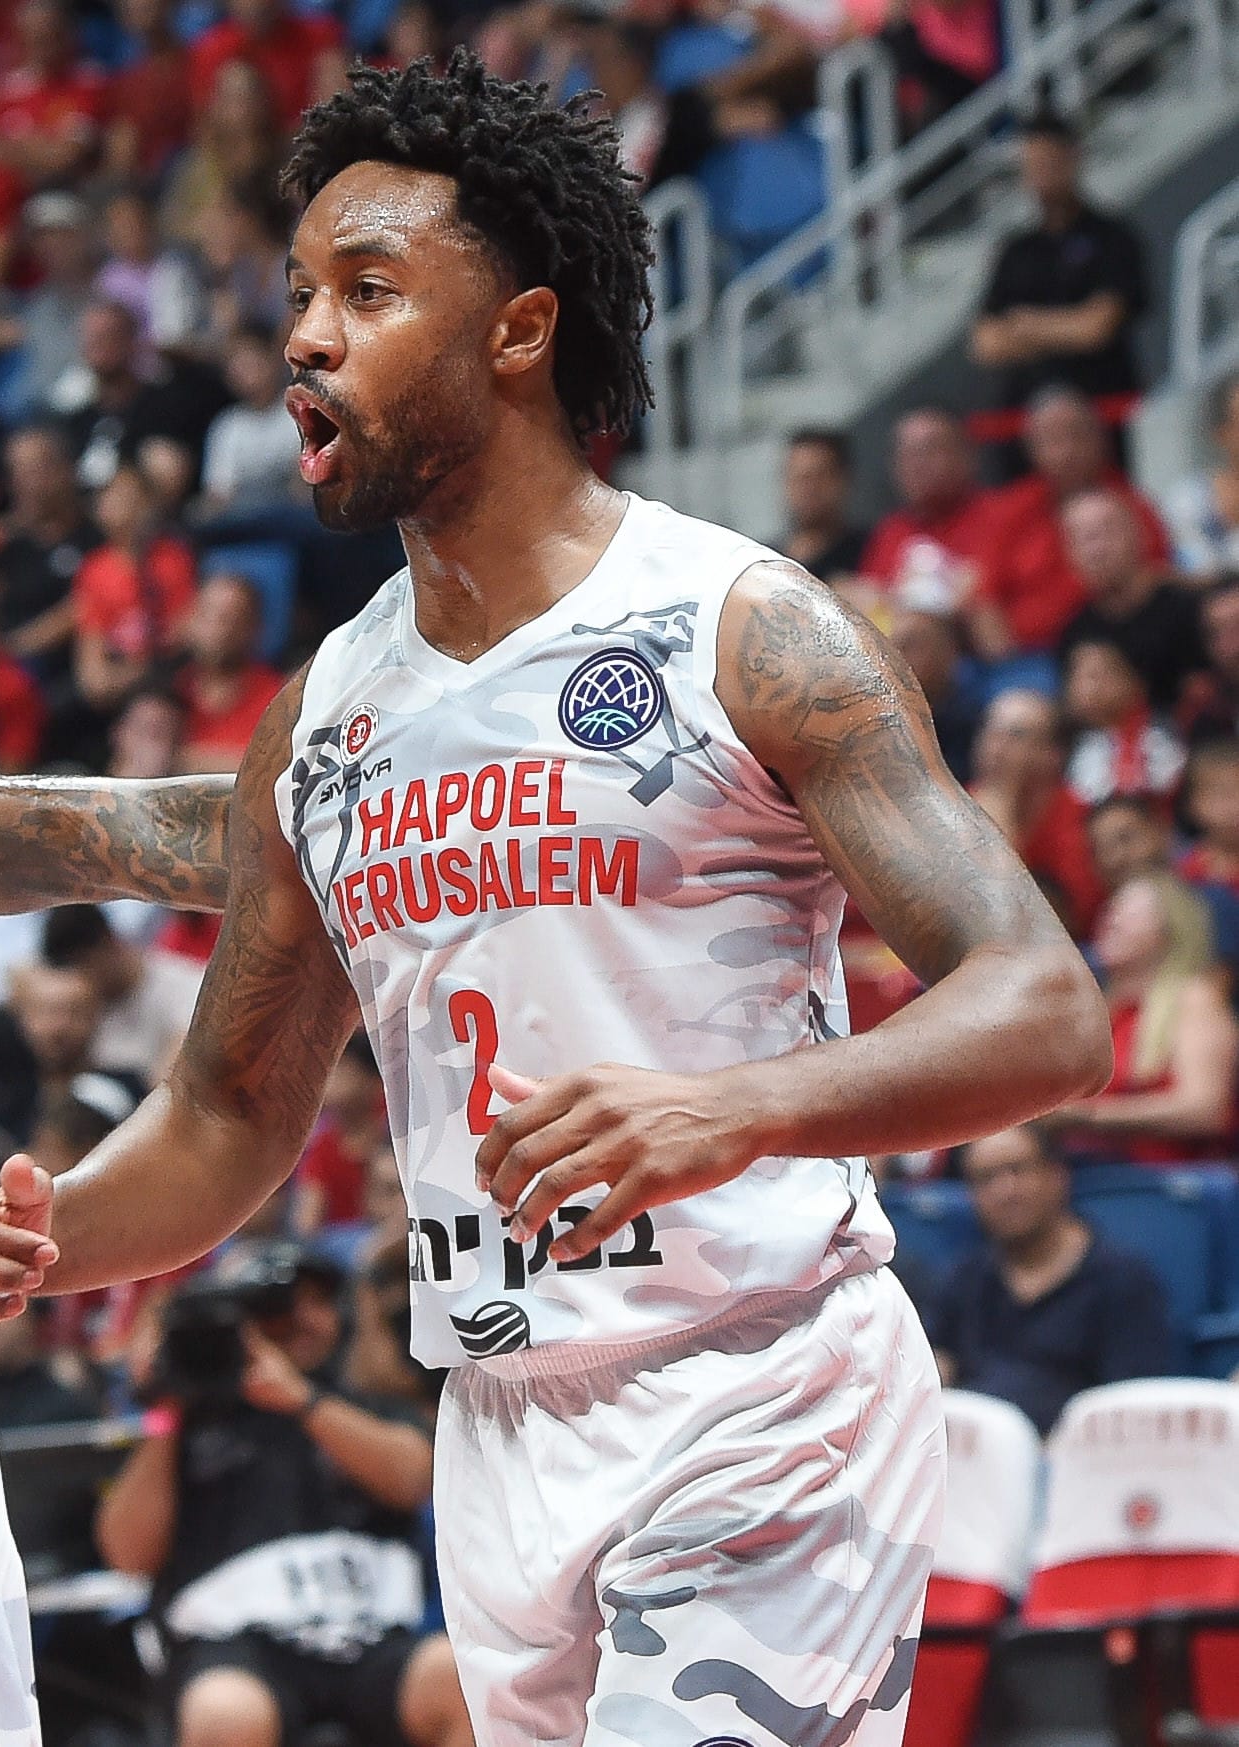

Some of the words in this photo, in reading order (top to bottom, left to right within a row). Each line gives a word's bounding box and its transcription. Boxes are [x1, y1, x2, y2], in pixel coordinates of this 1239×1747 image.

[358, 759, 576, 857] HAPOEL
[332, 837, 639, 950] JERUSALEM
[448, 989, 500, 1136] 2
